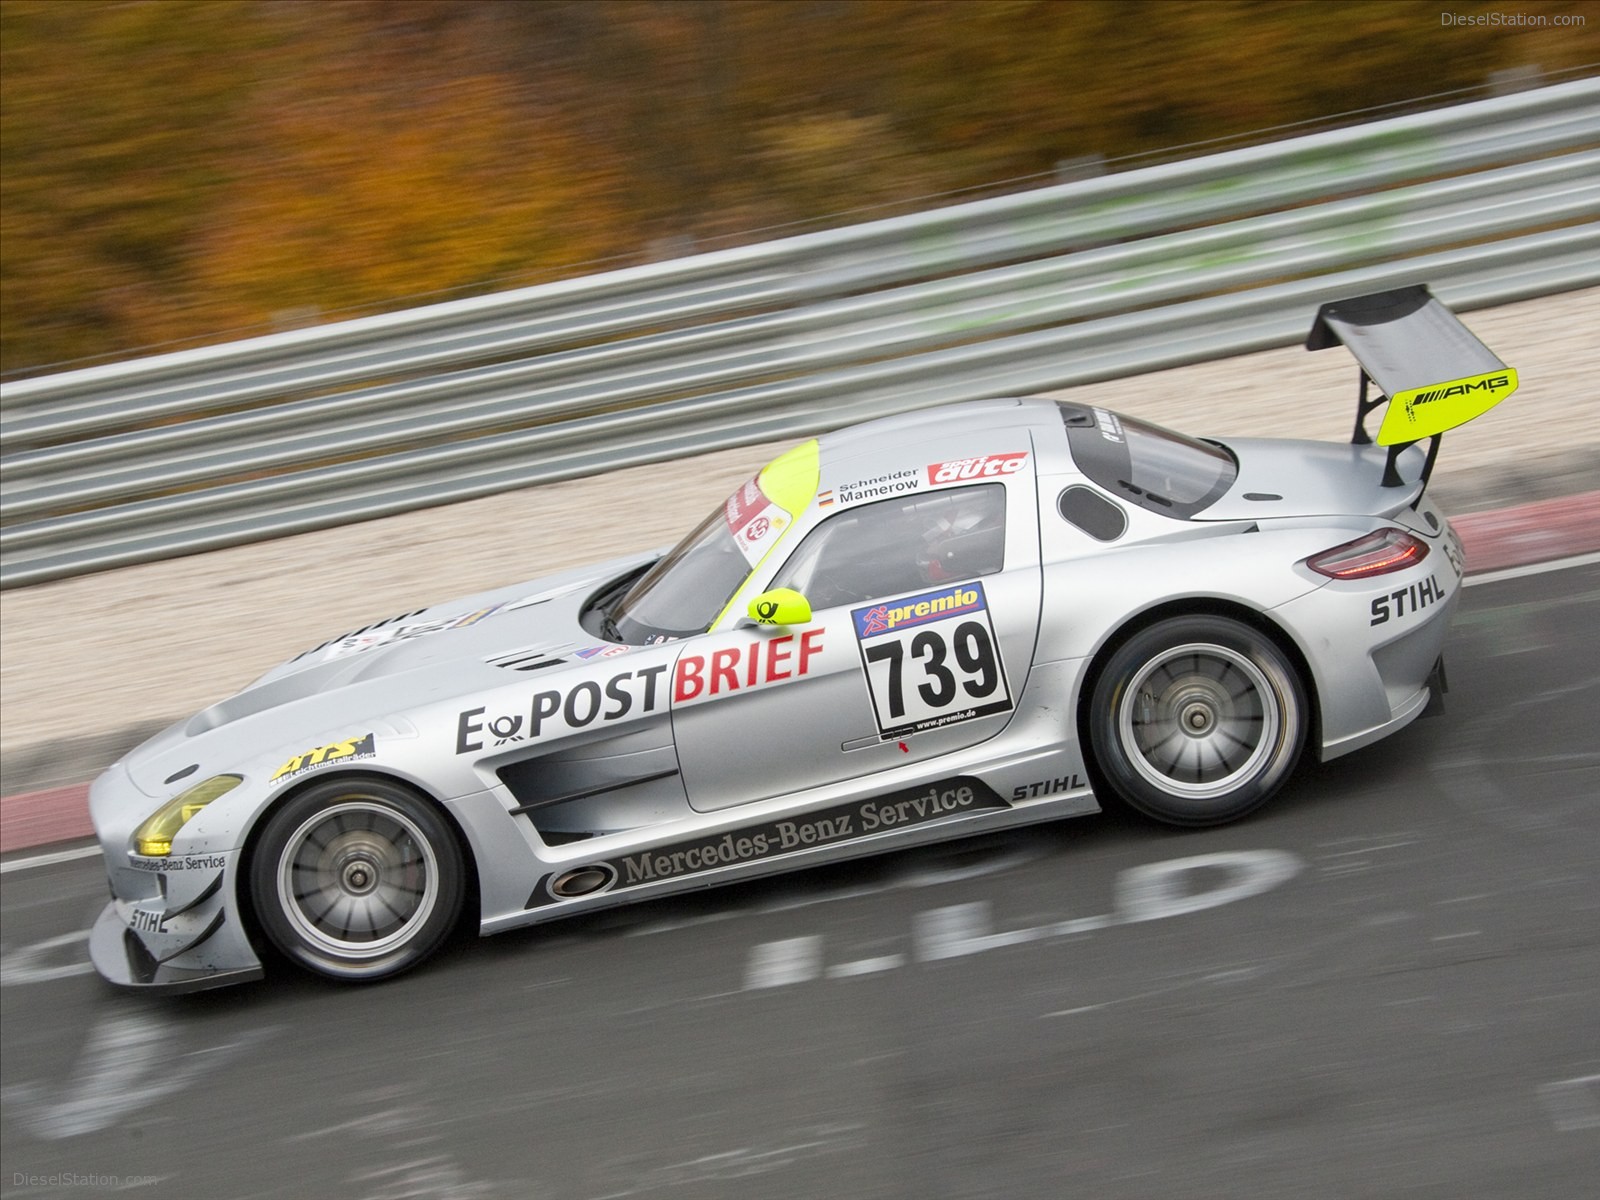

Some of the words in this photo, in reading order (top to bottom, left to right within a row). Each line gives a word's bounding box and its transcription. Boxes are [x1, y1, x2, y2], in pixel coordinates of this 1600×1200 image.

[1443, 375, 1509, 399] AMG
[839, 469, 919, 493] Schneider
[934, 458, 1026, 483] auto
[839, 479, 919, 504] Mamerow
[887, 589, 978, 628] premio
[1370, 574, 1445, 627] STIHL
[865, 621, 998, 719] 739
[917, 709, 976, 730] www.premio.de
[1012, 774, 1085, 801] STIHL
[622, 818, 854, 885] Mercedes-Benz
[859, 786, 974, 831] Service
[185, 856, 225, 870] Service
[129, 908, 168, 934] STIHL
